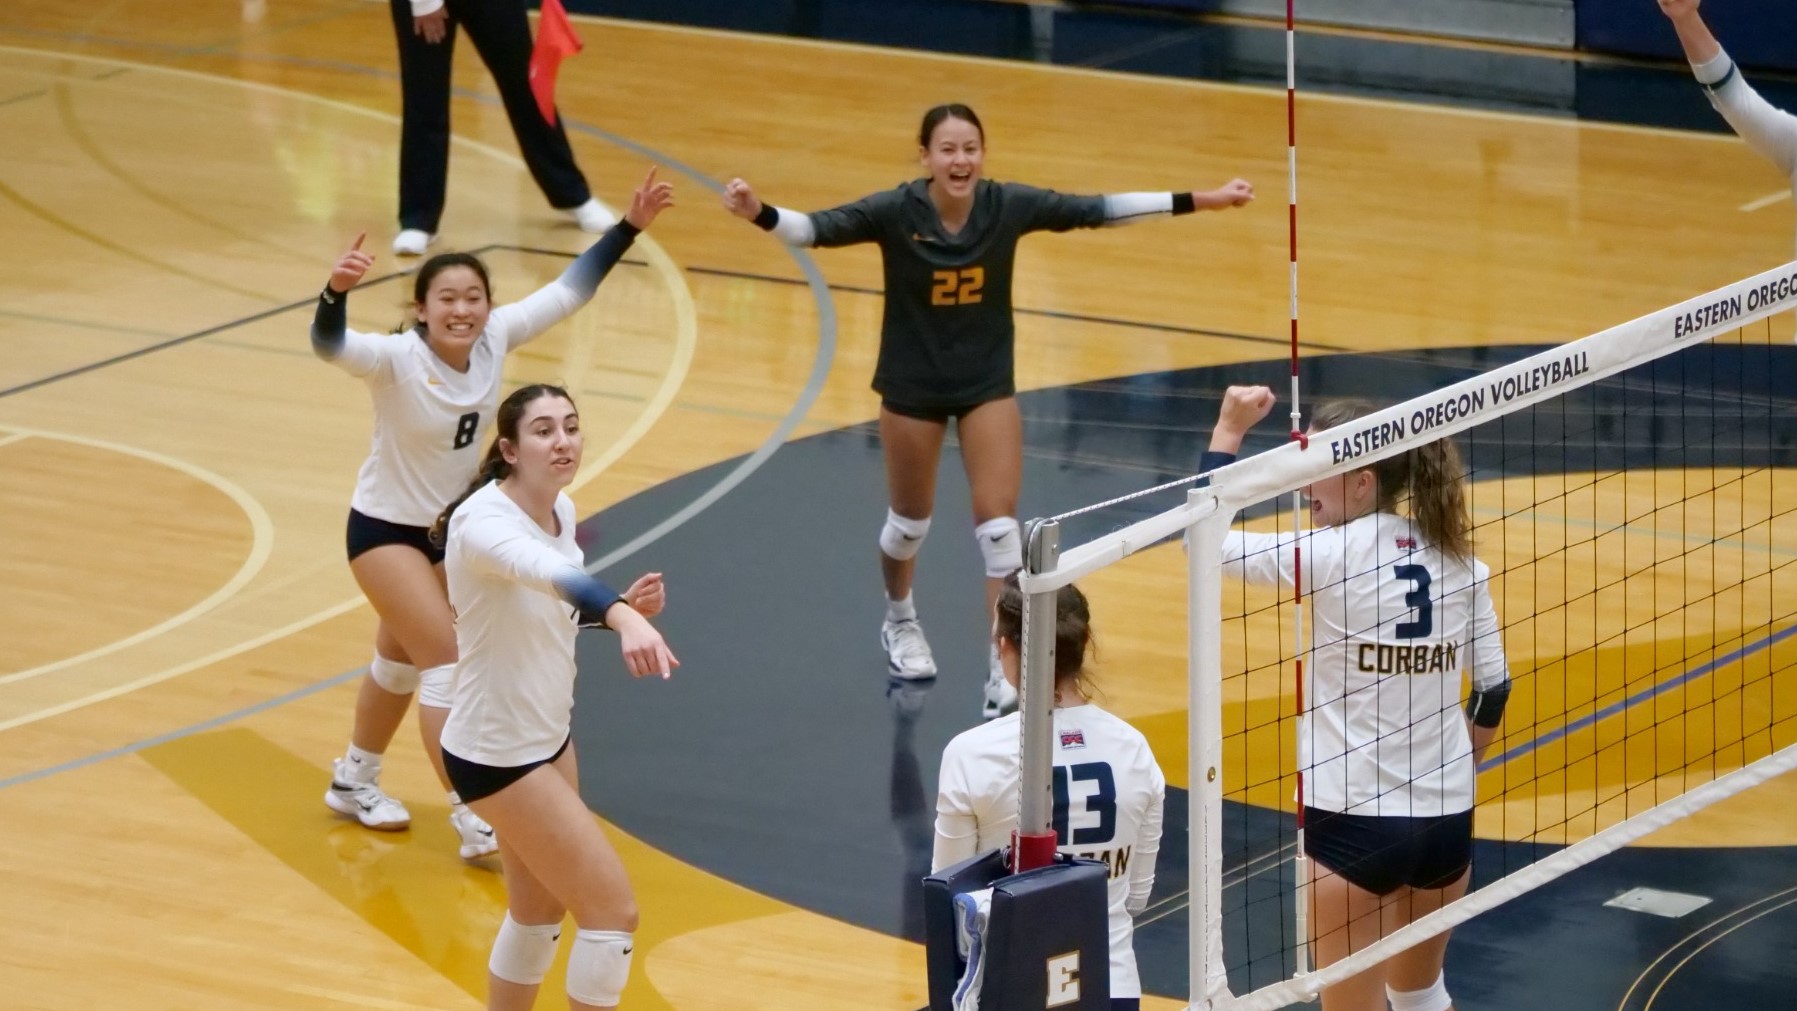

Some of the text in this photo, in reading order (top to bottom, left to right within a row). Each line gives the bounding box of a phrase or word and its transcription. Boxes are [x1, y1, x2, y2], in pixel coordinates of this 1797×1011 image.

[931, 266, 985, 306] 22
[1674, 273, 1797, 339] EASTERN OREGO
[453, 411, 480, 450] 8
[1331, 351, 1590, 465] EASTERN OREGON VOLLEYBALL
[1394, 564, 1432, 639] 3
[1358, 640, 1459, 674] CORBAN
[1052, 761, 1116, 846] 13
[1046, 950, 1080, 1009] E
